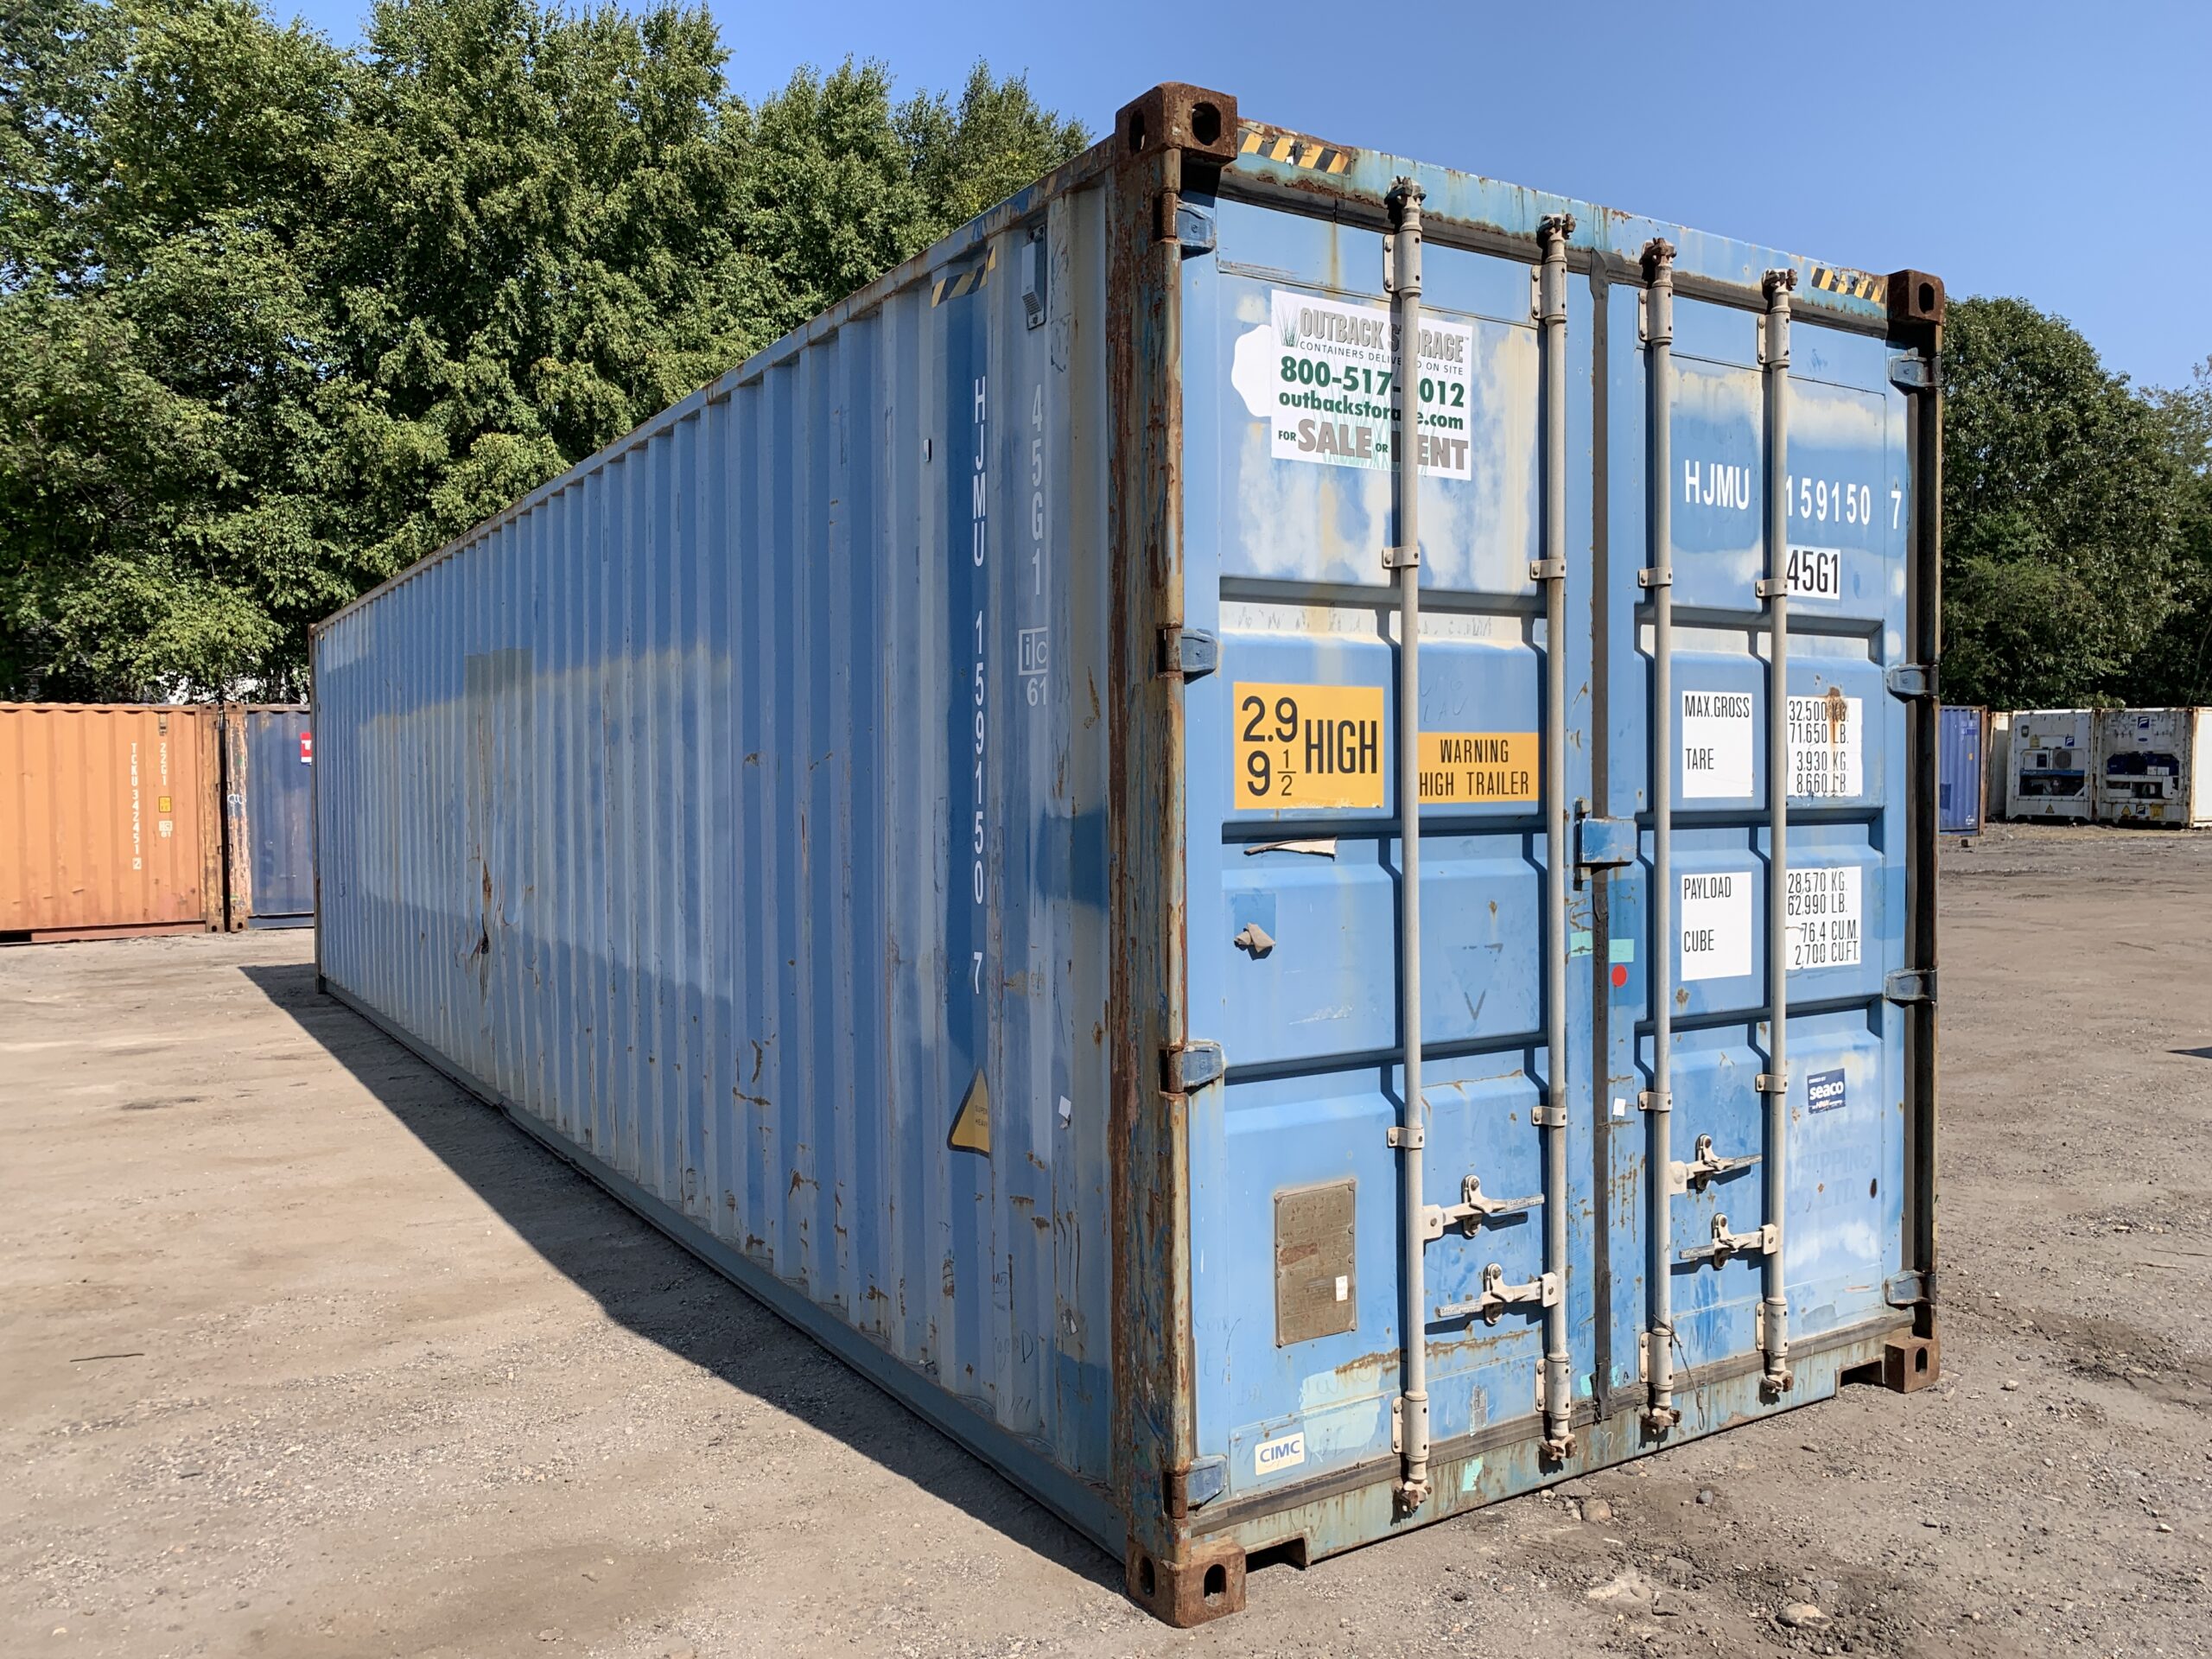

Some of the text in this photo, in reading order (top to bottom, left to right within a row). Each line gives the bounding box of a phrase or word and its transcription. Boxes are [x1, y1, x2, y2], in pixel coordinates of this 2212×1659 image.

[1300, 307, 1384, 350] OUTBACK
[1388, 323, 1464, 363] SRAGE
[1300, 340, 1464, 375] CONTAINERS DELIVED ON SITE
[1281, 355, 1465, 408] 800-517-012
[1279, 390, 1464, 430] outbackstorae.com
[1278, 430, 1296, 442] FOR
[1298, 418, 1372, 459] SALE
[1376, 442, 1389, 453] OR
[1031, 384, 1044, 595] 45G1
[1685, 459, 1902, 530] HJMU 159150 7
[1787, 549, 1838, 594] 45G1
[973, 375, 986, 995] HJMU 159150 7
[1685, 695, 1750, 718] MAX.GROSS
[1789, 701, 1827, 722] 32,500
[1242, 696, 1298, 743] 2.9
[1789, 723, 1827, 744] 71,650
[1306, 719, 1377, 774] HIGH
[1440, 740, 1509, 763] WARNING
[1686, 748, 1715, 770] TARE
[1796, 751, 1827, 772] 3,930
[1419, 771, 1529, 796] HIGH TRAILER
[1684, 876, 1732, 900] PAYLOAD
[1788, 872, 1827, 894] 28,570
[1788, 893, 1827, 916] 62,990
[1684, 930, 1714, 953] CUBE
[1801, 921, 1826, 944] 76.4
[1796, 943, 1826, 966] 2,700
[1809, 1081, 1844, 1101] seaco
[1260, 1440, 1300, 1463] CIMC
